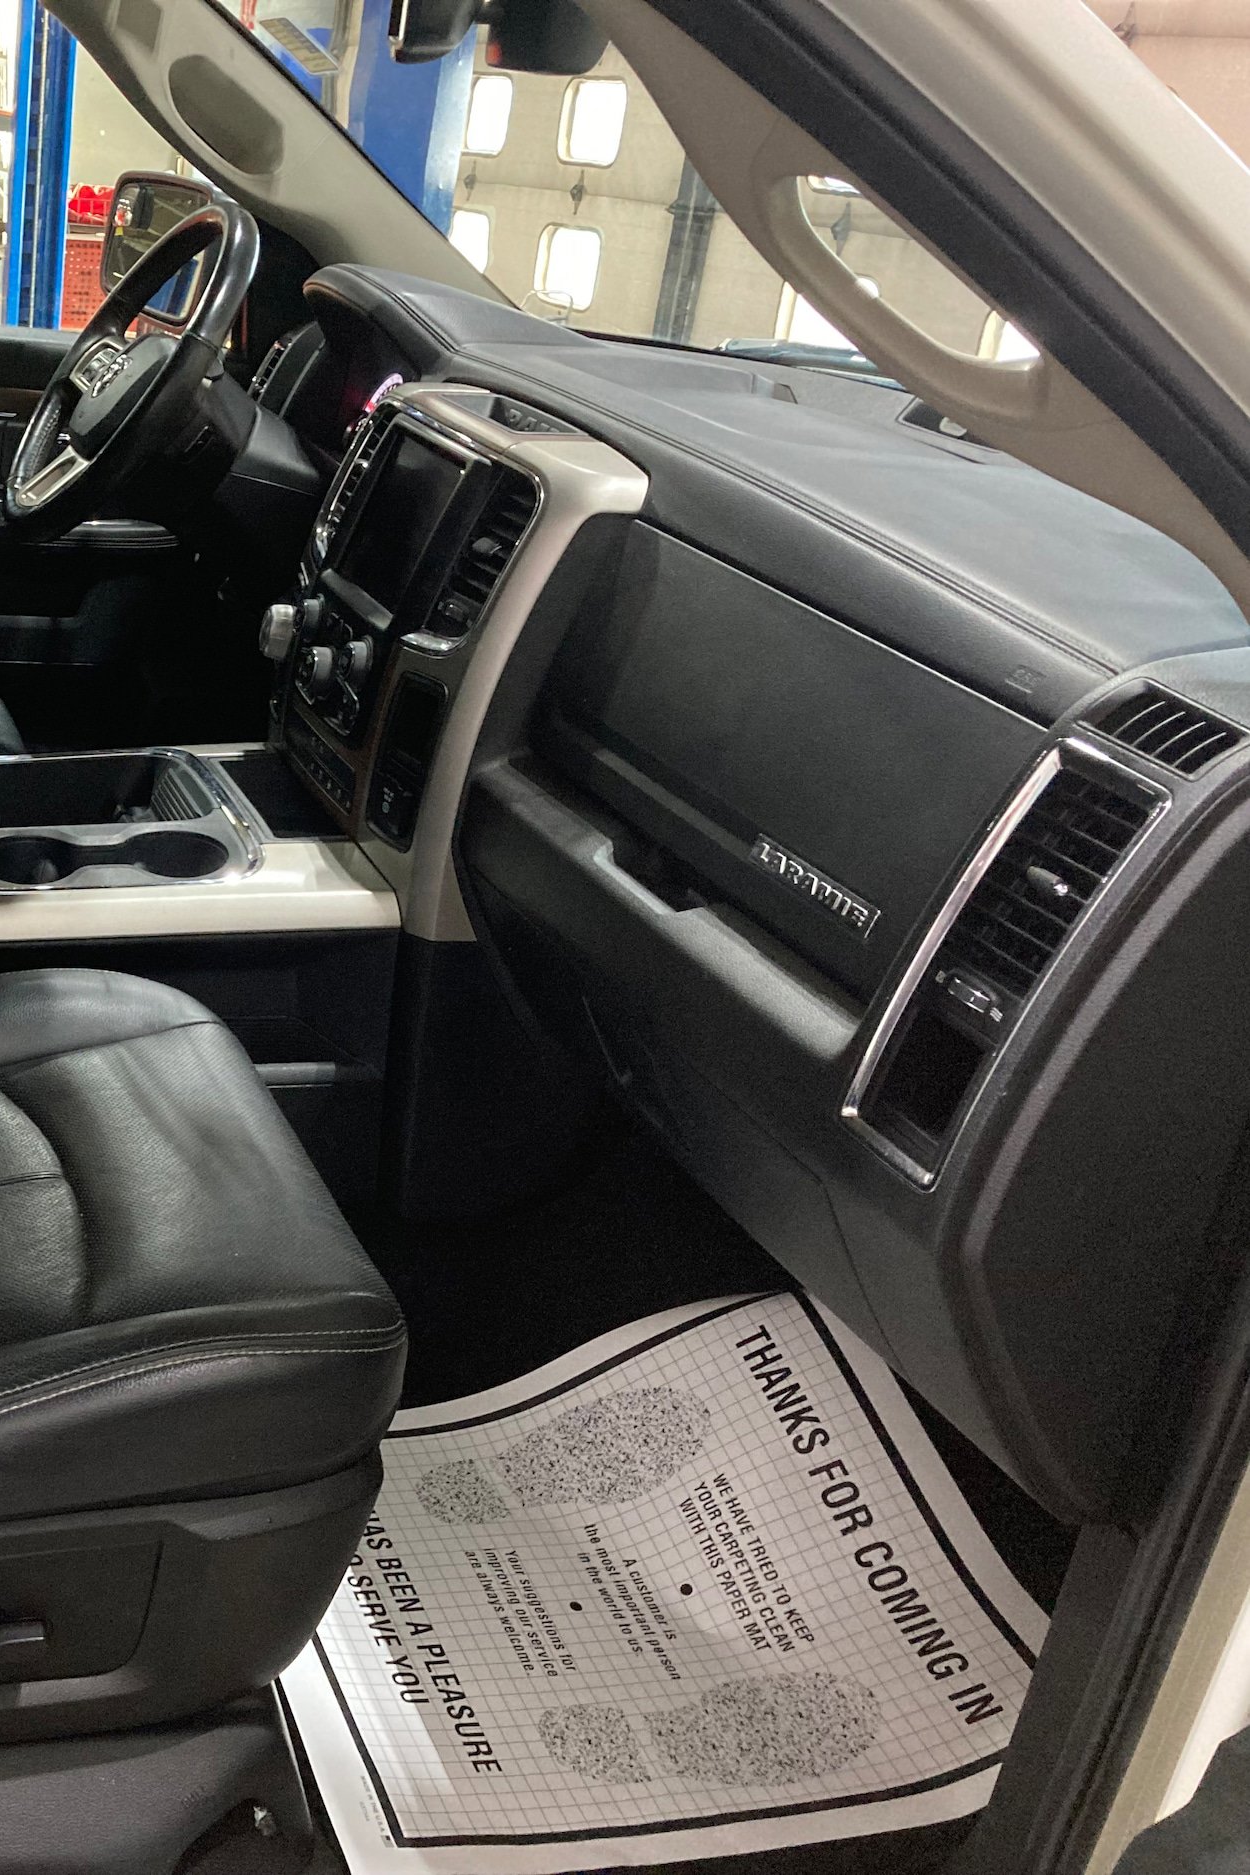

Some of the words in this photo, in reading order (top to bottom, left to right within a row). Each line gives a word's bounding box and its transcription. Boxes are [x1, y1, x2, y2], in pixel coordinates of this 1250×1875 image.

[375, 1557, 425, 1613] BEEN
[622, 1559, 637, 1568] A
[679, 1498, 706, 1535] WITH
[699, 1534, 724, 1569] THIS
[716, 1570, 752, 1621] PAPER
[743, 1622, 772, 1651] MAT
[694, 1481, 722, 1521] YOUR
[715, 1521, 766, 1604] CARPETING
[759, 1607, 796, 1652] CLEAN
[713, 1473, 734, 1497] WE
[725, 1498, 755, 1535] HAVE
[747, 1535, 779, 1582] TRIED
[772, 1584, 791, 1606] TO
[784, 1608, 815, 1643] KEEP
[736, 1324, 830, 1455] THANKS
[808, 1459, 874, 1536] FOR
[854, 1541, 969, 1681] COMING
[948, 1683, 1004, 1725] IN
[347, 1575, 402, 1647] SERVE
[385, 1655, 430, 1705] YOU
[405, 1620, 434, 1637] A
[465, 1550, 482, 1569] are
[476, 1572, 505, 1613] always
[499, 1616, 535, 1676] welcome.
[483, 1547, 520, 1605] improving
[515, 1608, 533, 1629] our
[527, 1631, 558, 1677] service
[505, 1550, 525, 1576] Your
[519, 1579, 565, 1651] suggestions
[558, 1654, 576, 1672] for
[577, 1552, 591, 1563] in
[586, 1566, 603, 1585] the
[598, 1587, 626, 1620] world
[618, 1622, 632, 1635] to
[584, 1523, 601, 1544] the
[595, 1547, 621, 1577] most
[613, 1579, 655, 1636] important
[645, 1638, 681, 1680] person
[629, 1571, 669, 1626] customer
[664, 1629, 677, 1641] is
[417, 1643, 503, 1774] PLEASURE
